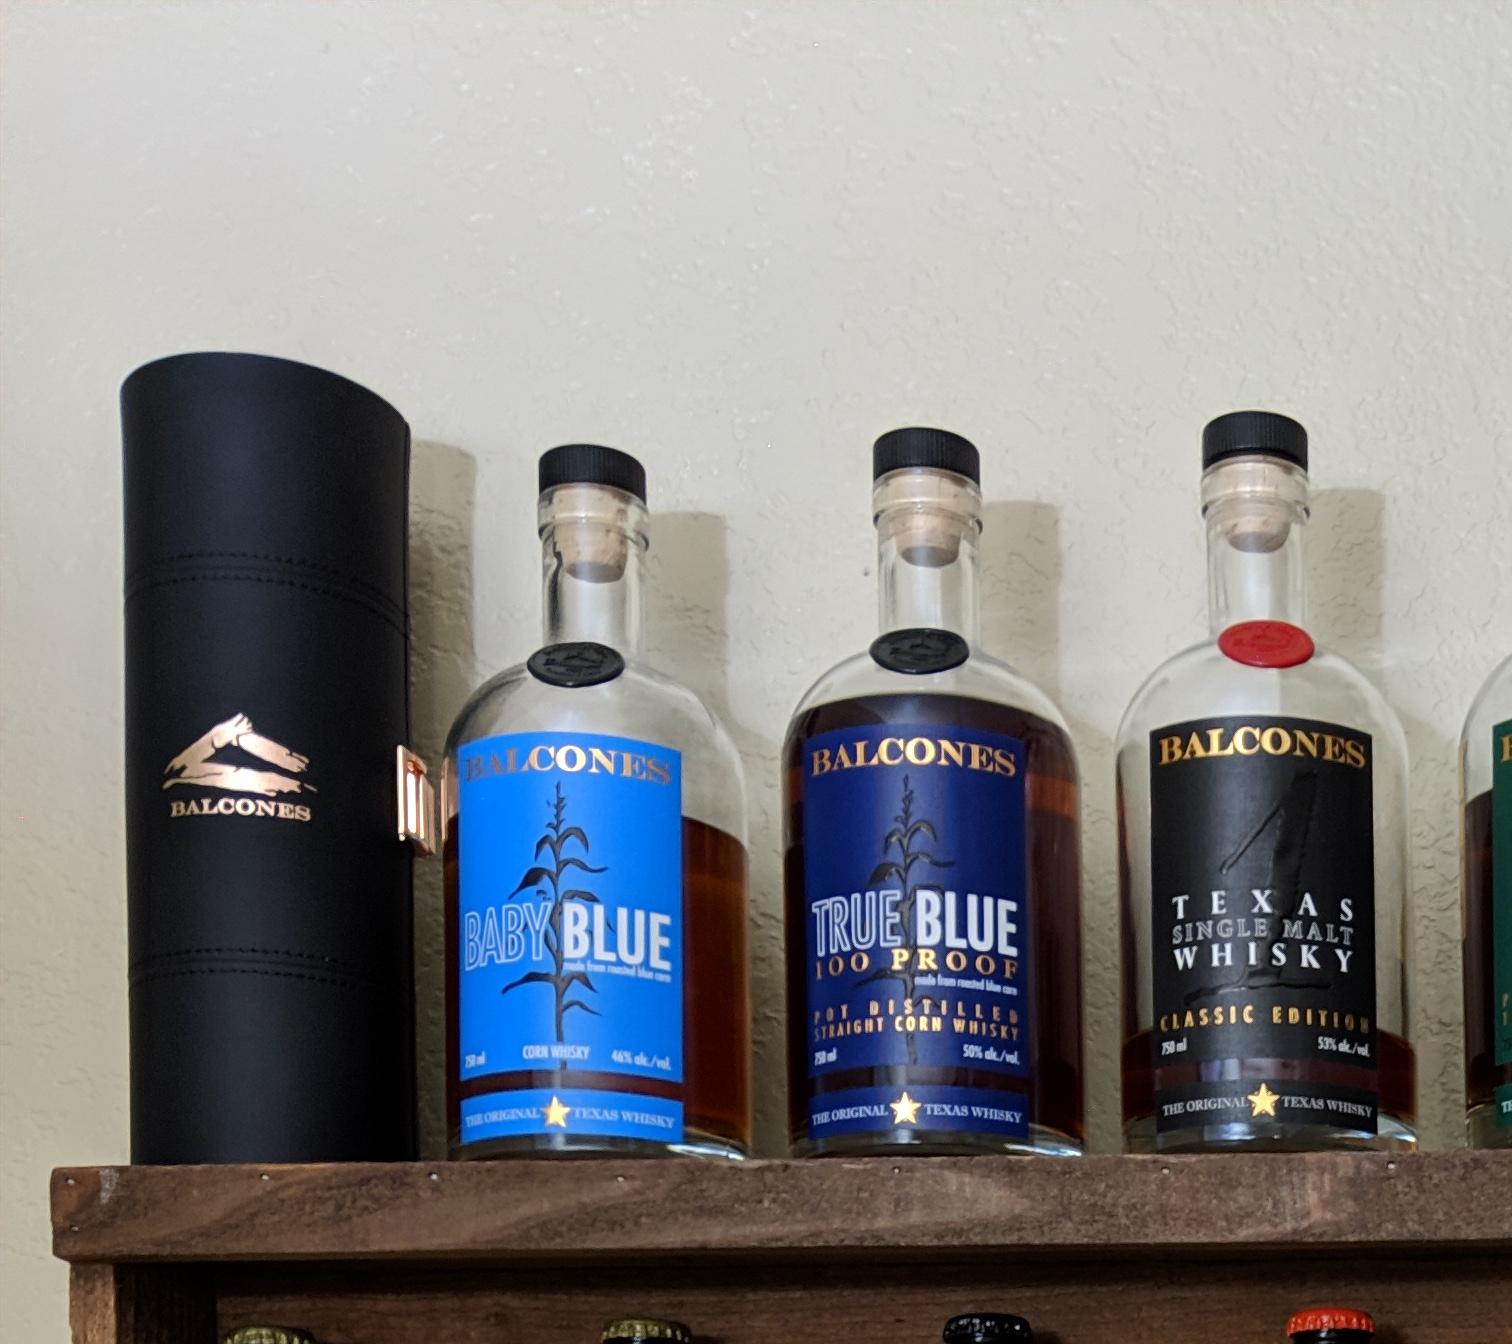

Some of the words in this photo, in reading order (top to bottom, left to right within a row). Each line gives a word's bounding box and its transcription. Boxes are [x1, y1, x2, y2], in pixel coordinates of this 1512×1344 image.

[811, 737, 1016, 777] BALCONES
[1158, 727, 1365, 768] BALCONES
[465, 746, 670, 785] BALCONES
[170, 799, 311, 822] BALCONES
[1172, 889, 1353, 922] TEXAS
[464, 902, 552, 971] BABY
[563, 903, 672, 973] BLUE
[812, 890, 900, 957] TRUE
[916, 889, 1018, 957] BLUE
[816, 952, 870, 980] 100
[891, 948, 1017, 979] PROOF
[1173, 942, 1352, 973] WHISKY
[812, 1113, 830, 1125] THE
[831, 1105, 888, 1120] ORIGINAL
[924, 1105, 968, 1116] TEXAS
[970, 1106, 1022, 1123] WHISKY
[1163, 1104, 1184, 1116] THE
[1186, 1098, 1249, 1113] ORIGINAL
[1281, 1096, 1325, 1108] TEXAS
[1326, 1099, 1373, 1117] WHISKY
